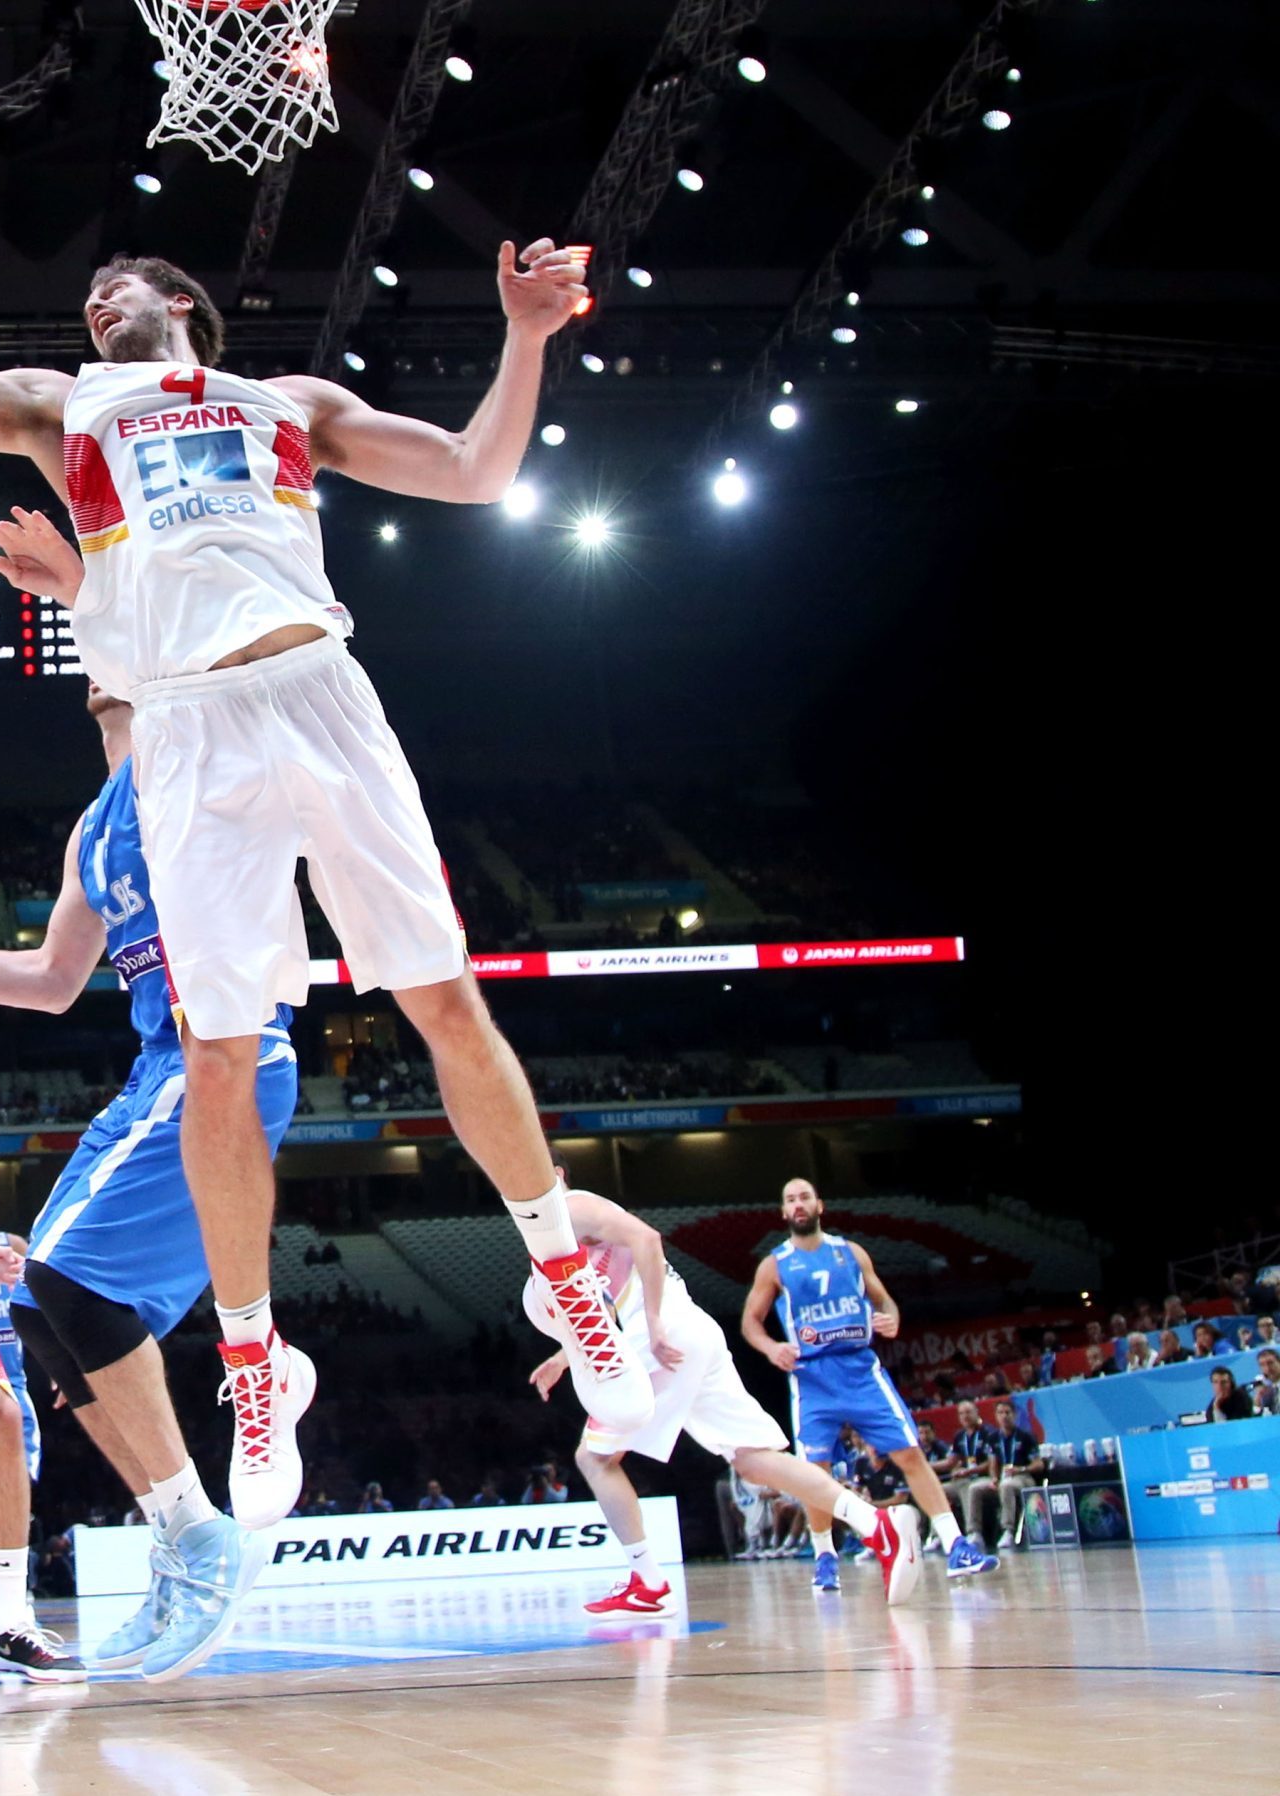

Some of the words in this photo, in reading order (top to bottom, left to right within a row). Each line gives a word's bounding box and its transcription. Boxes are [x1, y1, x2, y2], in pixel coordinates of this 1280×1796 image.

[160, 369, 206, 405] 4
[117, 404, 253, 439] ESPAÑA
[149, 491, 256, 531] endesa
[599, 955, 650, 967] JAPAN
[655, 952, 730, 965] AIRLINES
[803, 946, 856, 961] JAPAN
[857, 943, 933, 959] AIRLINES
[471, 959, 523, 972] LINES
[601, 1110, 631, 1127] LILLE
[812, 1270, 830, 1296] 7
[800, 1295, 860, 1323] HELLAS
[819, 1328, 865, 1343] Eurobank
[266, 1536, 370, 1565] PAN
[382, 1522, 610, 1560] AIRLINES
